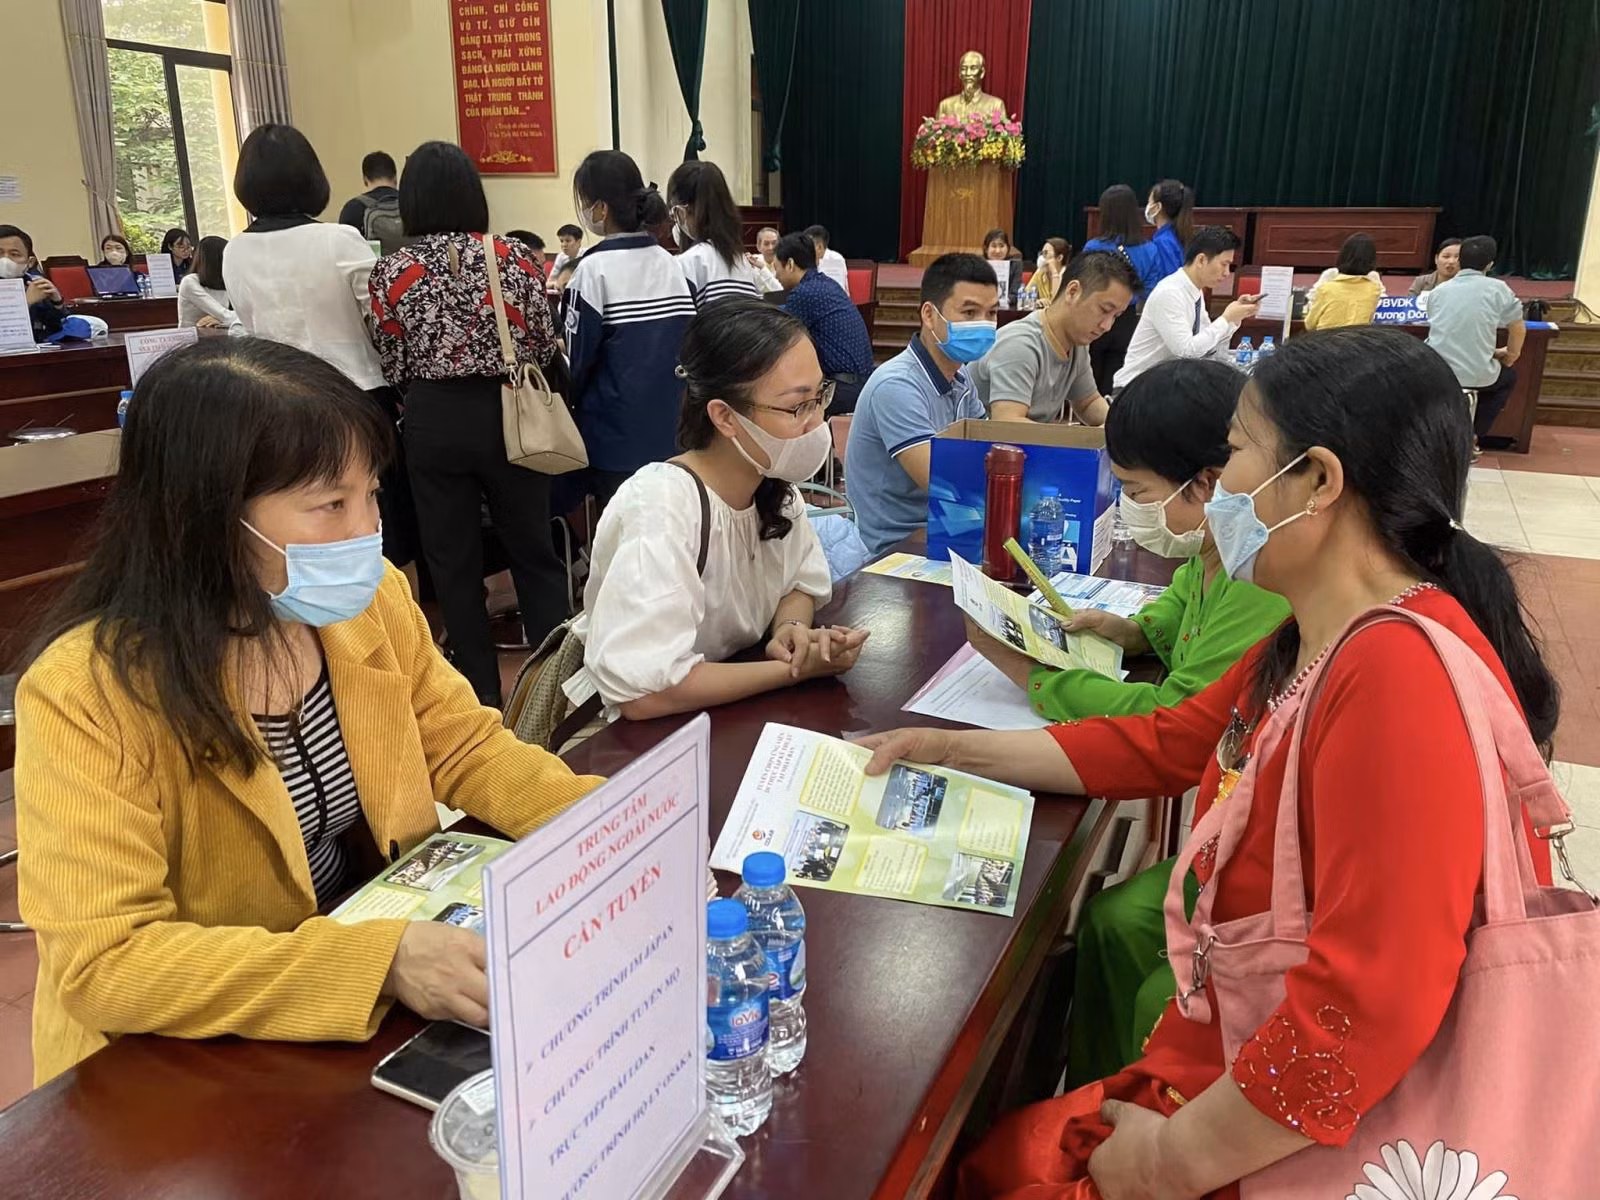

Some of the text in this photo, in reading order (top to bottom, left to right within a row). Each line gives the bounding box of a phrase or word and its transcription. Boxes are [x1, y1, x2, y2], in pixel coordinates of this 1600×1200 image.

[514, 1, 539, 12] CÔNG
[482, 35, 492, 44] TA
[514, 32, 541, 42] TRONG
[487, 92, 512, 102] TRUNG
[577, 793, 648, 857] TRUNG TÂM
[535, 883, 566, 915] LAO
[563, 861, 662, 959] CẦN TUYỂN
[540, 1001, 593, 1059] CHƯƠNG
[643, 920, 673, 960] JAPAN
[628, 1042, 655, 1078] LOAN
[662, 1050, 692, 1088] OSAKA
